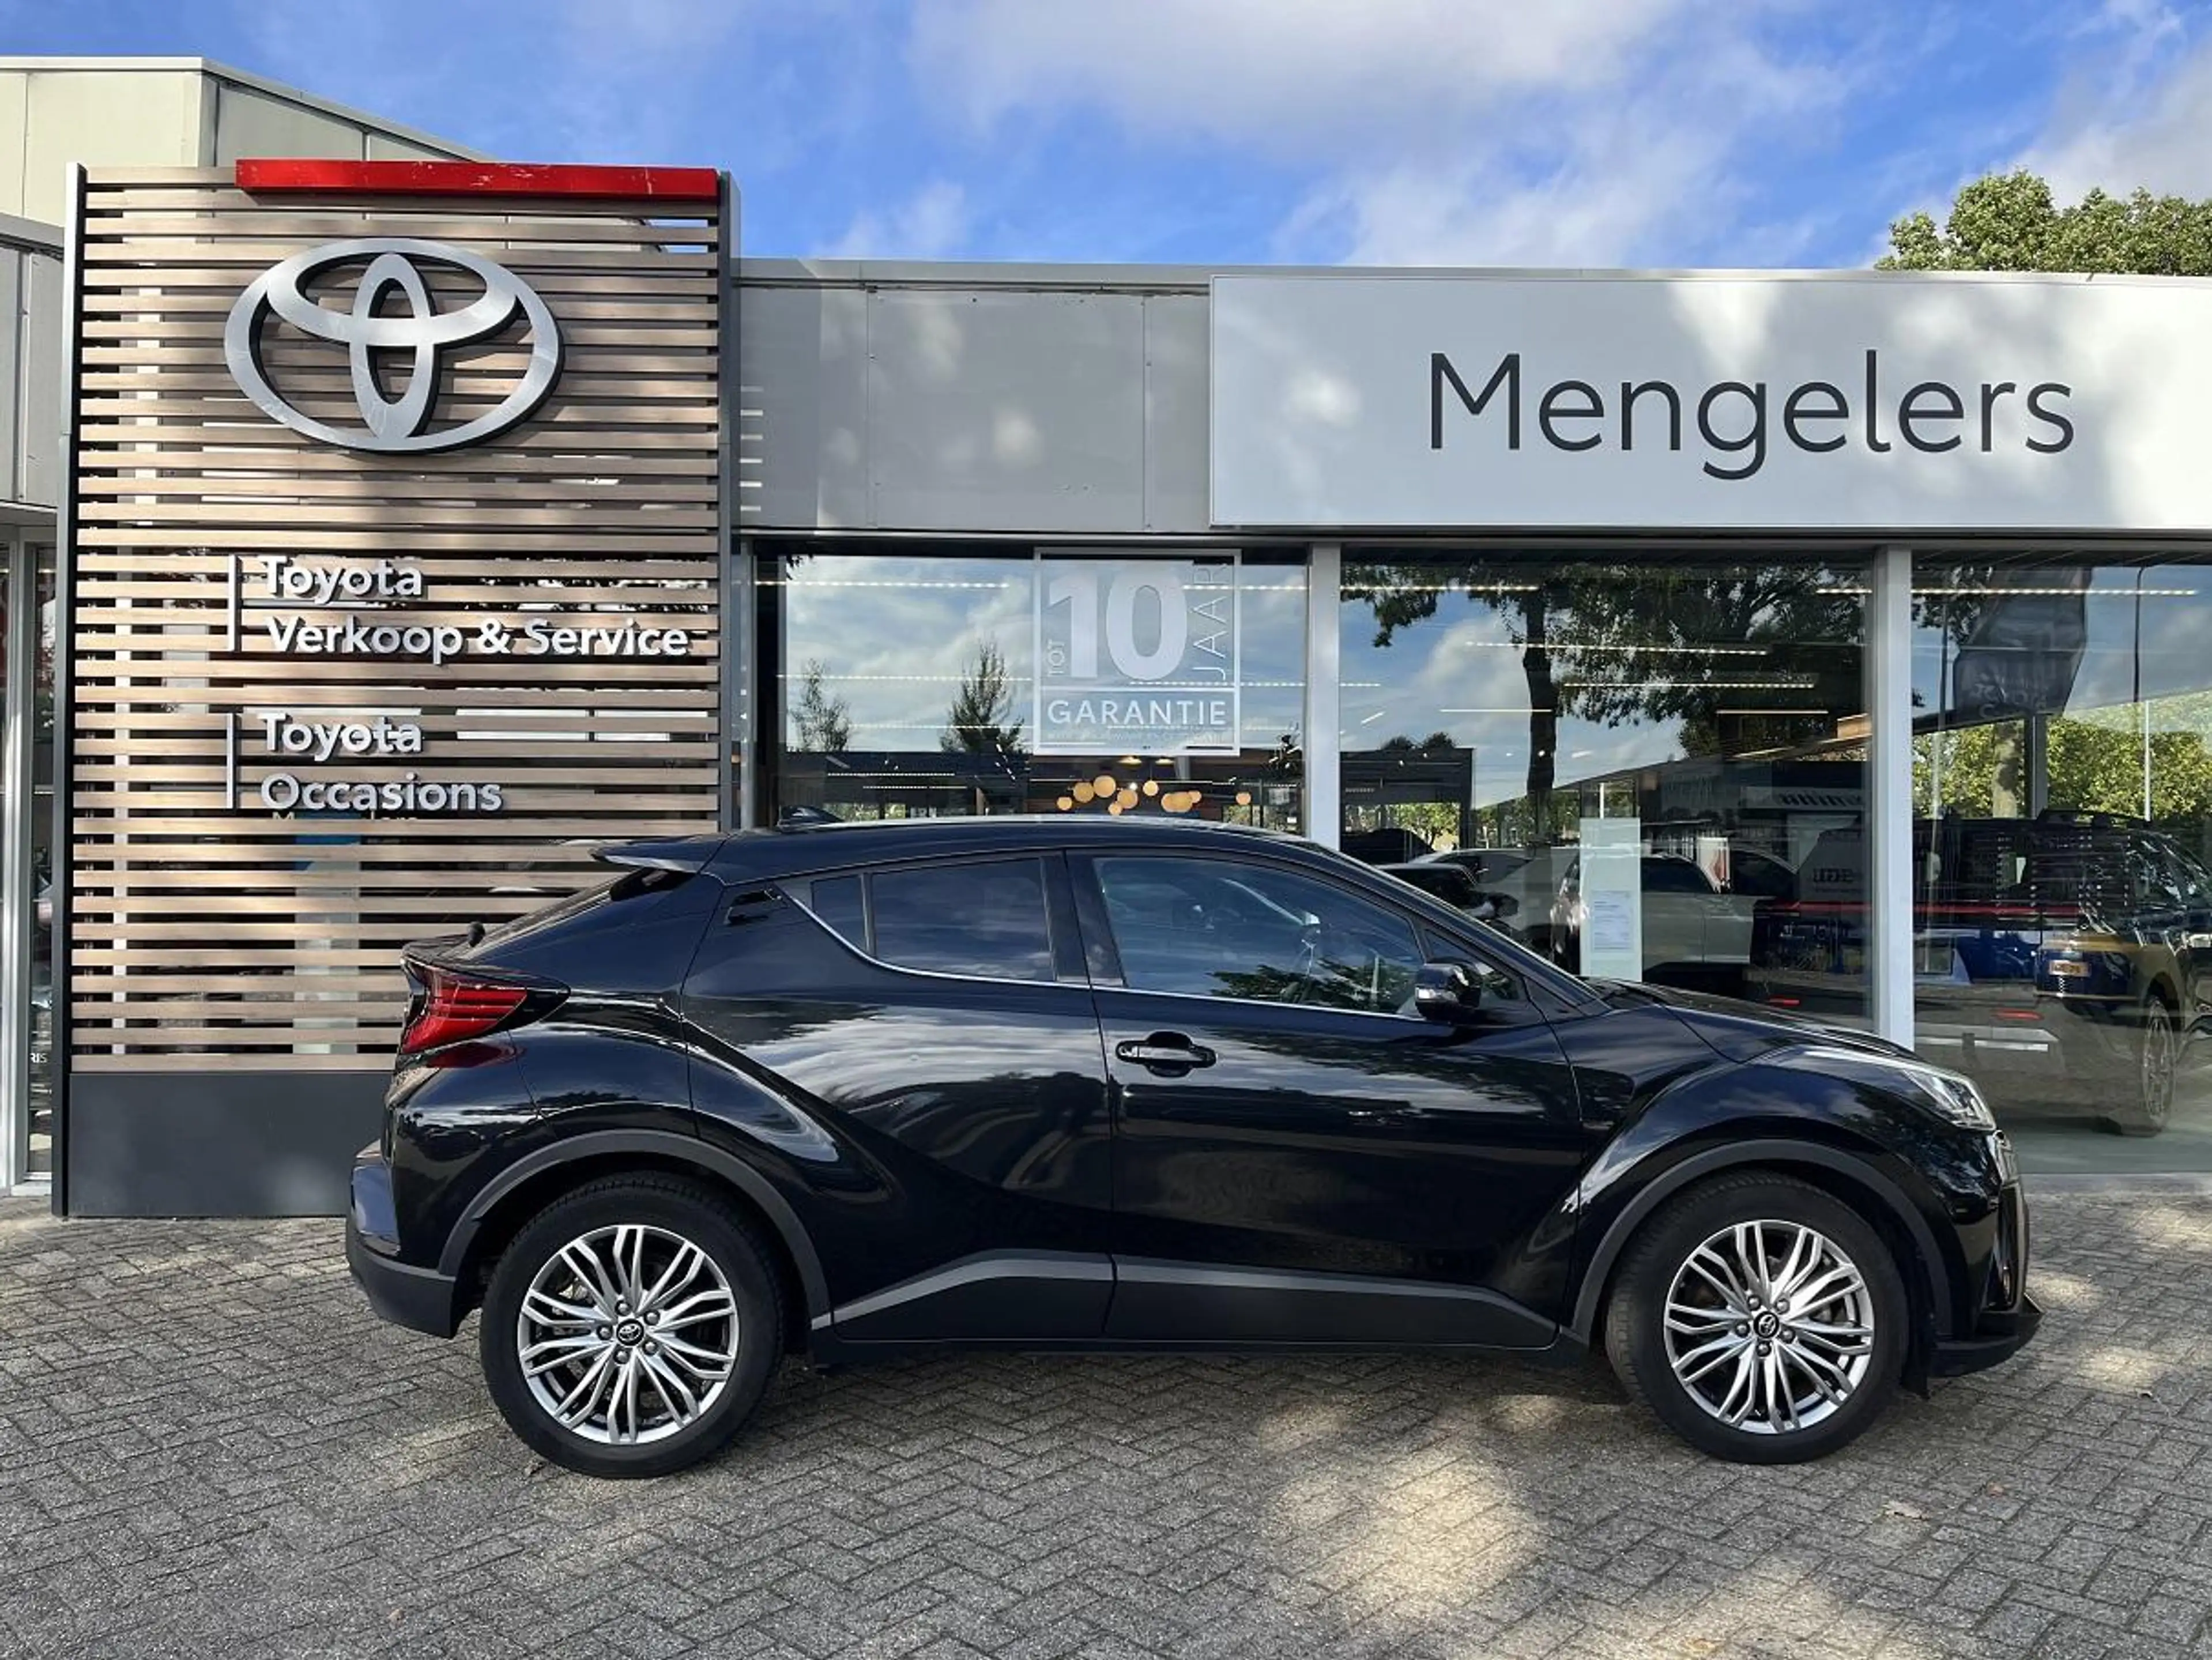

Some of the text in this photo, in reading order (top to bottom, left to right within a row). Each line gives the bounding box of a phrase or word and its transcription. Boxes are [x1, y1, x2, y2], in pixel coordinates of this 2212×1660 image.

[1430, 349, 2075, 480] Mengelers
[259, 555, 424, 604] Toyota
[267, 615, 689, 665] Verkoop & Service
[1047, 568, 1188, 681] 10
[1191, 563, 1228, 681] JAAR
[258, 712, 424, 762] Toyota
[1047, 699, 1227, 725] GARANTIE
[261, 771, 503, 811] Occasions
